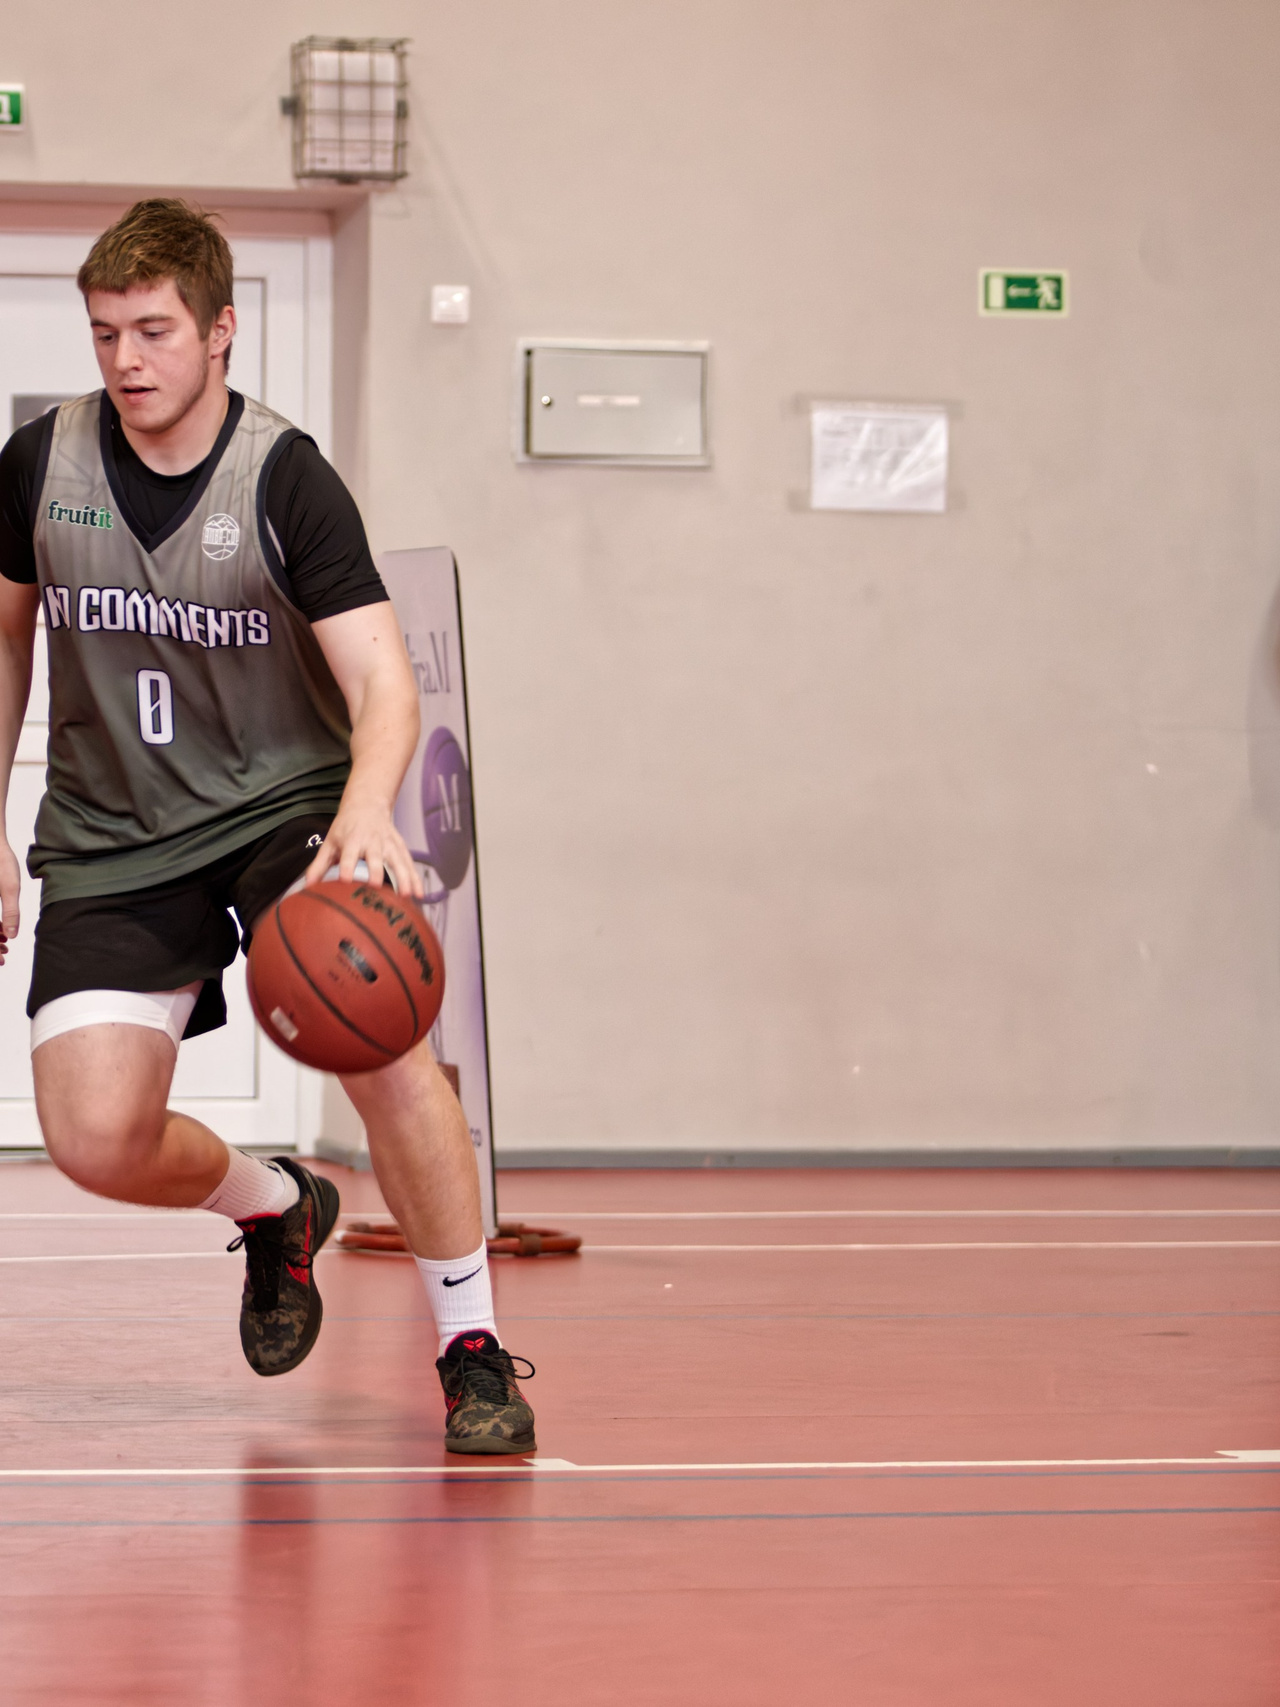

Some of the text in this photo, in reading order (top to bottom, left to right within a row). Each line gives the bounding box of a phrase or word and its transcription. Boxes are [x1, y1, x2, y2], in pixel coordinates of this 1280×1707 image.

[48, 500, 113, 529] fruitit
[78, 586, 270, 649] COMMENTS
[136, 668, 174, 745] 0
